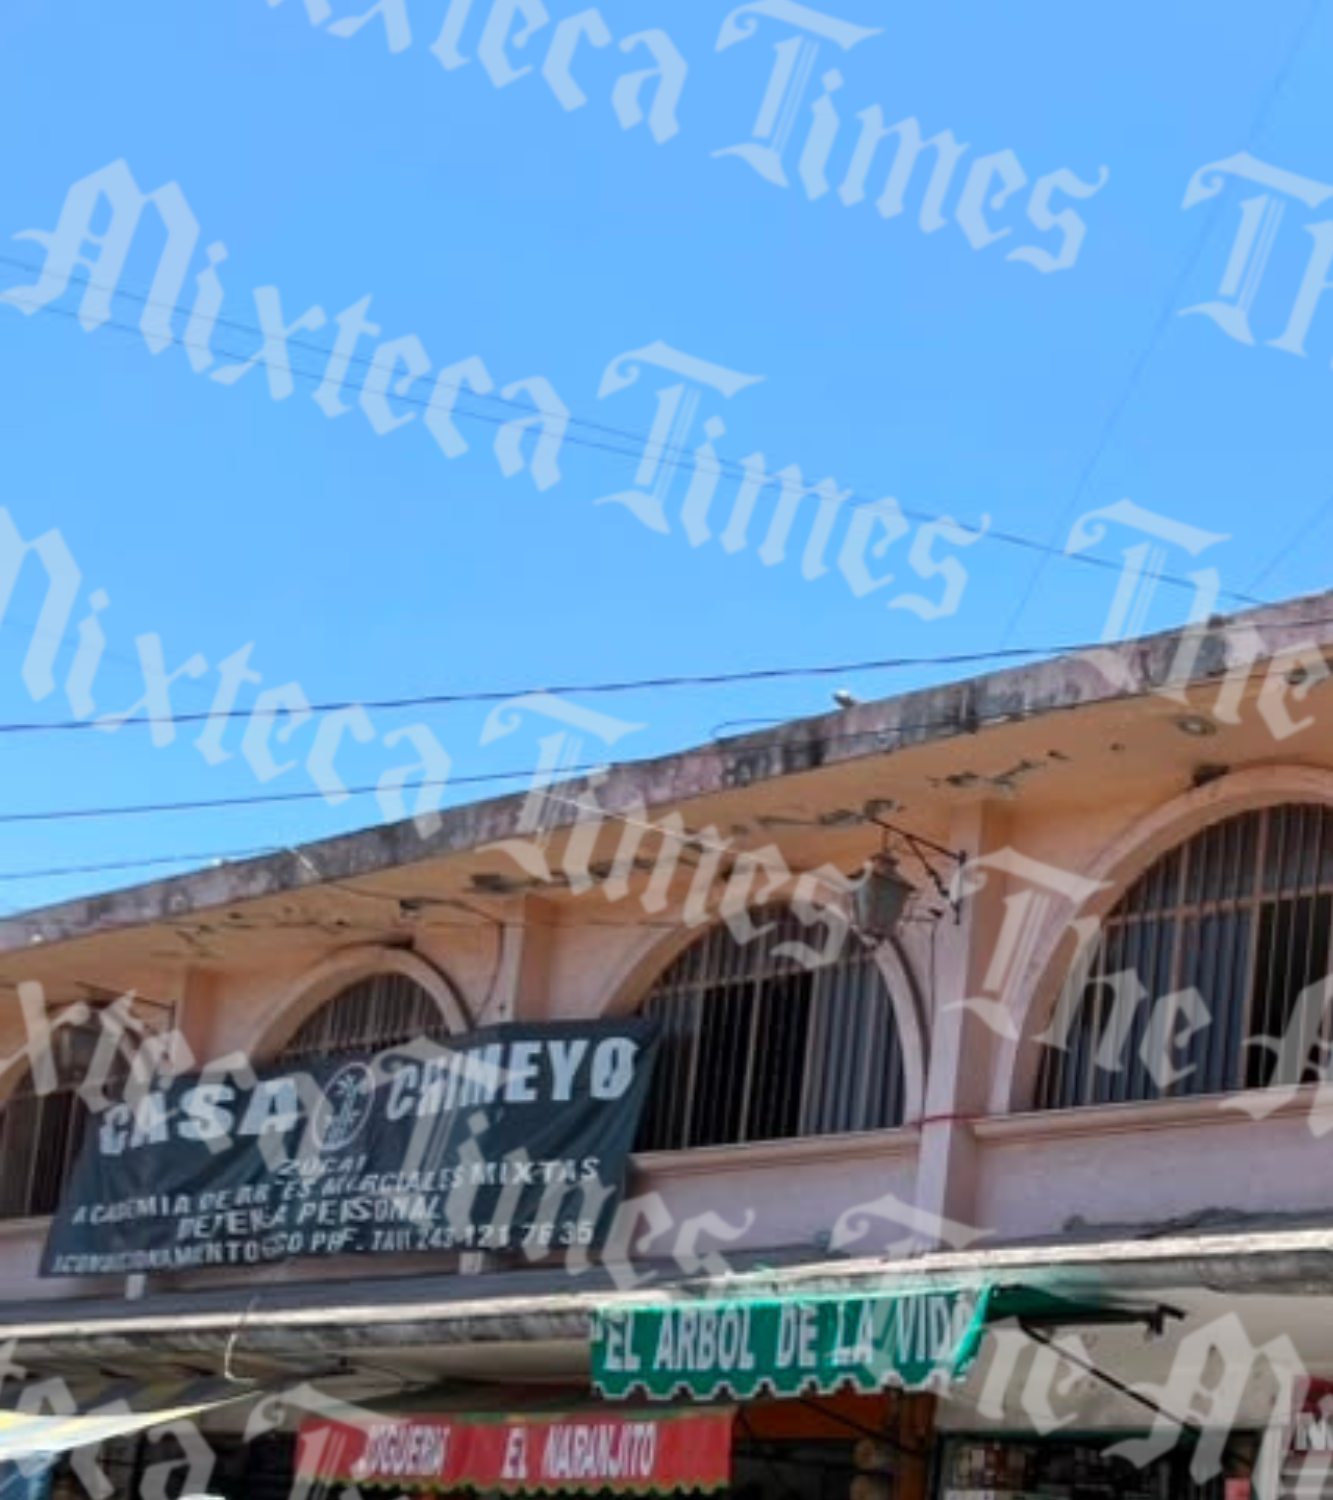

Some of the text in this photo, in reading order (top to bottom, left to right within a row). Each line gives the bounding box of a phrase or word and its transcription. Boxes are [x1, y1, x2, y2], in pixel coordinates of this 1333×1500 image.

[100, 1076, 297, 1156] CASA
[470, 1156, 600, 1186] MIXTAS
[652, 1302, 756, 1372] ARBOL
[775, 1301, 819, 1369] DE
[831, 1299, 874, 1366] LA
[502, 1426, 528, 1480] EL
[541, 1420, 657, 1480] NARANJITO
